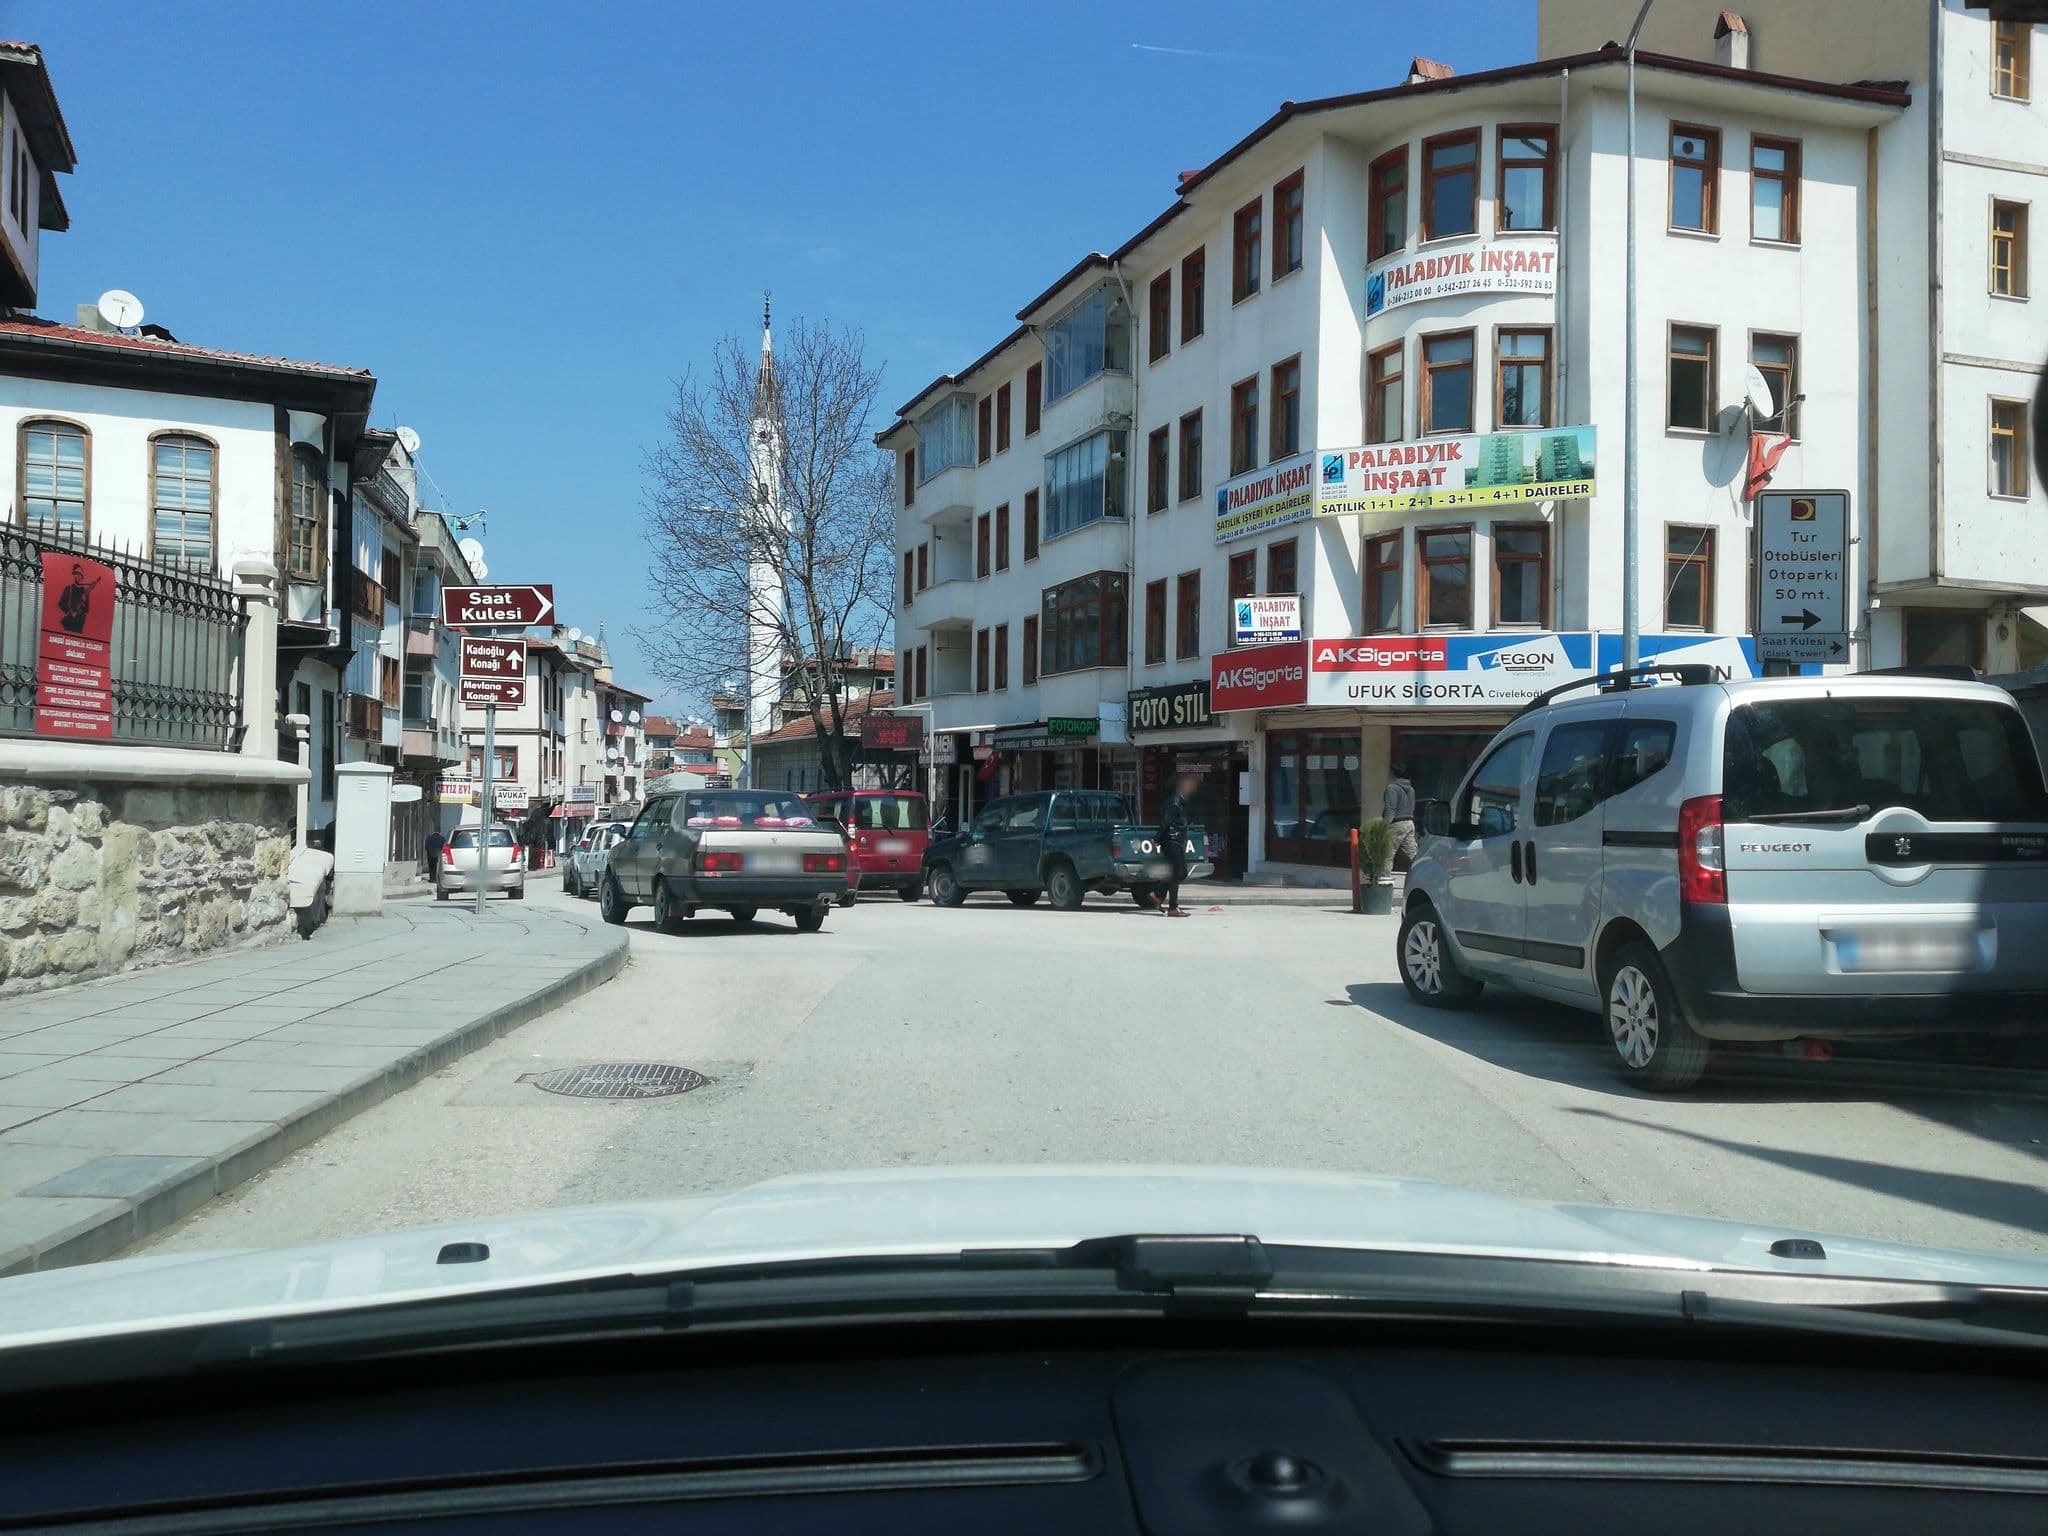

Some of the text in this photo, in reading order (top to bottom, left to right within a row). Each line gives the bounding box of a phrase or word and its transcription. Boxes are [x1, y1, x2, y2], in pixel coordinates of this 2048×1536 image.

[1387, 246, 1555, 291] PALABIYIK İNŞAAT
[1348, 442, 1462, 469] PALABIYIK
[1229, 463, 1312, 511] PALABIYIK İNŞAAT
[1364, 467, 1447, 494] İNŞAAT
[1321, 501, 1366, 513] SATILIK
[1371, 500, 1393, 509] 1+1
[1409, 497, 1433, 507] 2+1
[1449, 493, 1473, 504] 3+1
[1493, 489, 1518, 500] 4+1
[1525, 484, 1589, 498] DAİRELER
[1216, 516, 1241, 531] SATILIK
[1264, 504, 1273, 515] VE
[1275, 494, 1310, 512] DAİRELER
[1790, 532, 1818, 543] Tur
[1765, 550, 1841, 561] Otobüsleri
[1769, 569, 1838, 582] Otoparkı
[469, 592, 512, 605] Saat
[1776, 589, 1830, 600] 50 mt.
[1253, 600, 1296, 612] PALABIYIK
[461, 607, 522, 620] Kulesi
[1260, 614, 1291, 630] İNŞAAT
[1762, 637, 1826, 646] Saat Kulesi
[466, 644, 504, 657] Kadıoğlu
[470, 658, 500, 671] Konağı
[463, 681, 502, 690] Mevlana
[1348, 685, 1396, 698] UFUK
[1402, 681, 1484, 698] SİGORTA
[466, 692, 498, 702] Konağı
[1132, 684, 1208, 728] FOTO STİL
[497, 791, 528, 799] AVUKAT
[1740, 843, 1812, 853] PEUGEOT
